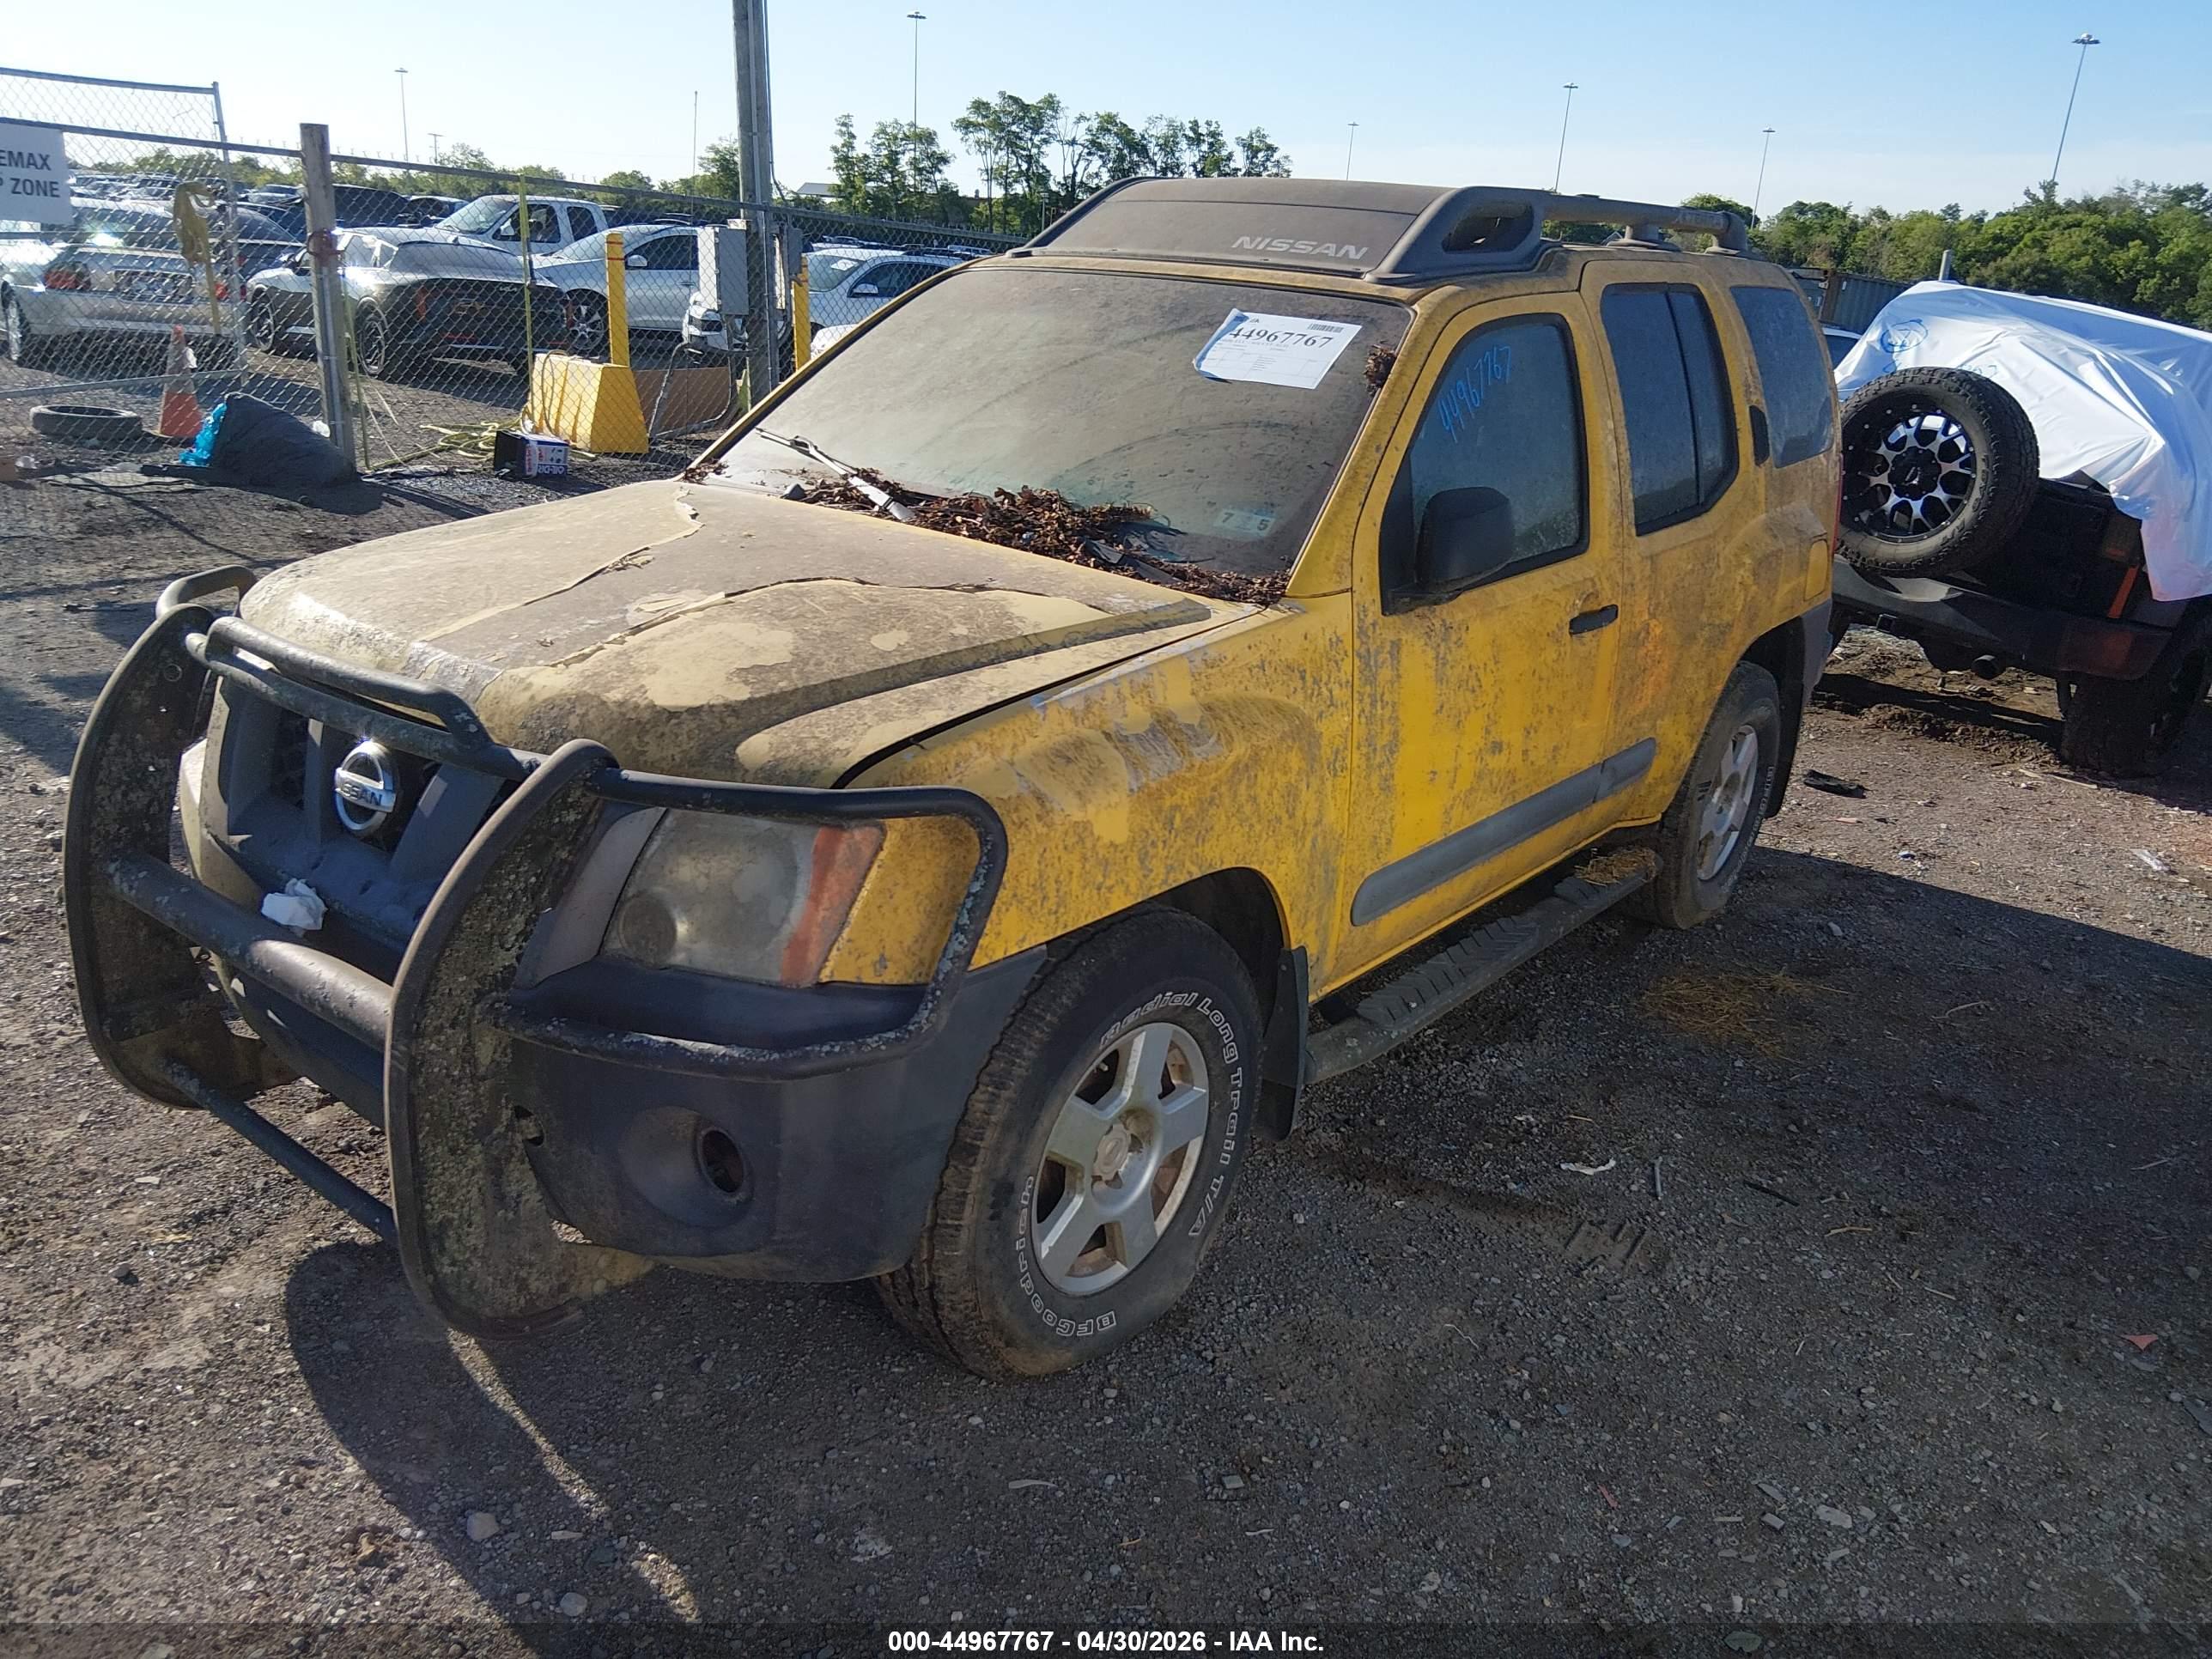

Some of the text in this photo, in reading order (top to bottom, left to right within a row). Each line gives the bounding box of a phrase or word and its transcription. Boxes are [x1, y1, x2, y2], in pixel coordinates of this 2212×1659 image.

[10, 178, 60, 198] ZONE
[1231, 236, 1369, 259] NISSAN
[1230, 327, 1334, 349] 44967767
[1196, 997, 1238, 1064] Long
[1219, 1067, 1243, 1165] Trail
[1188, 1175, 1224, 1236] T/A
[1016, 1176, 1116, 1336] BFGoodrich
